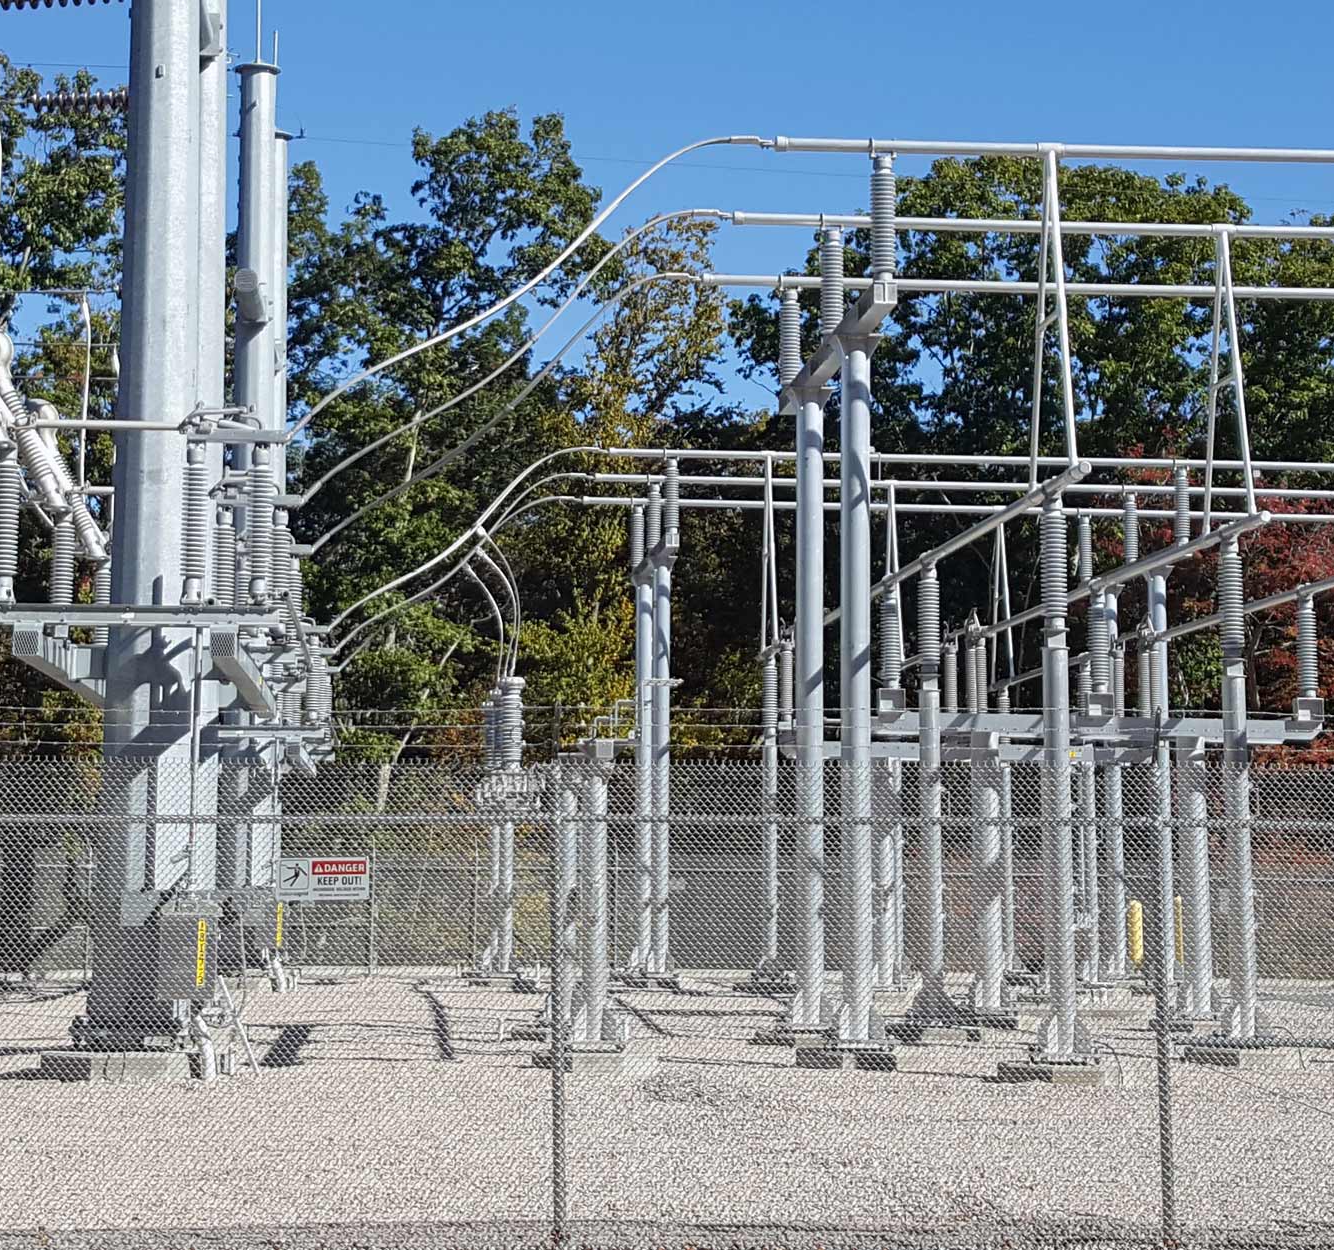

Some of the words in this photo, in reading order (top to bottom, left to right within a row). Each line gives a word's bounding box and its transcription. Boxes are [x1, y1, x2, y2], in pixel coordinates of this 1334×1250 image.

[324, 863, 365, 873] DANGER
[317, 876, 339, 886] KEEP
[341, 876, 362, 886] OUT!
